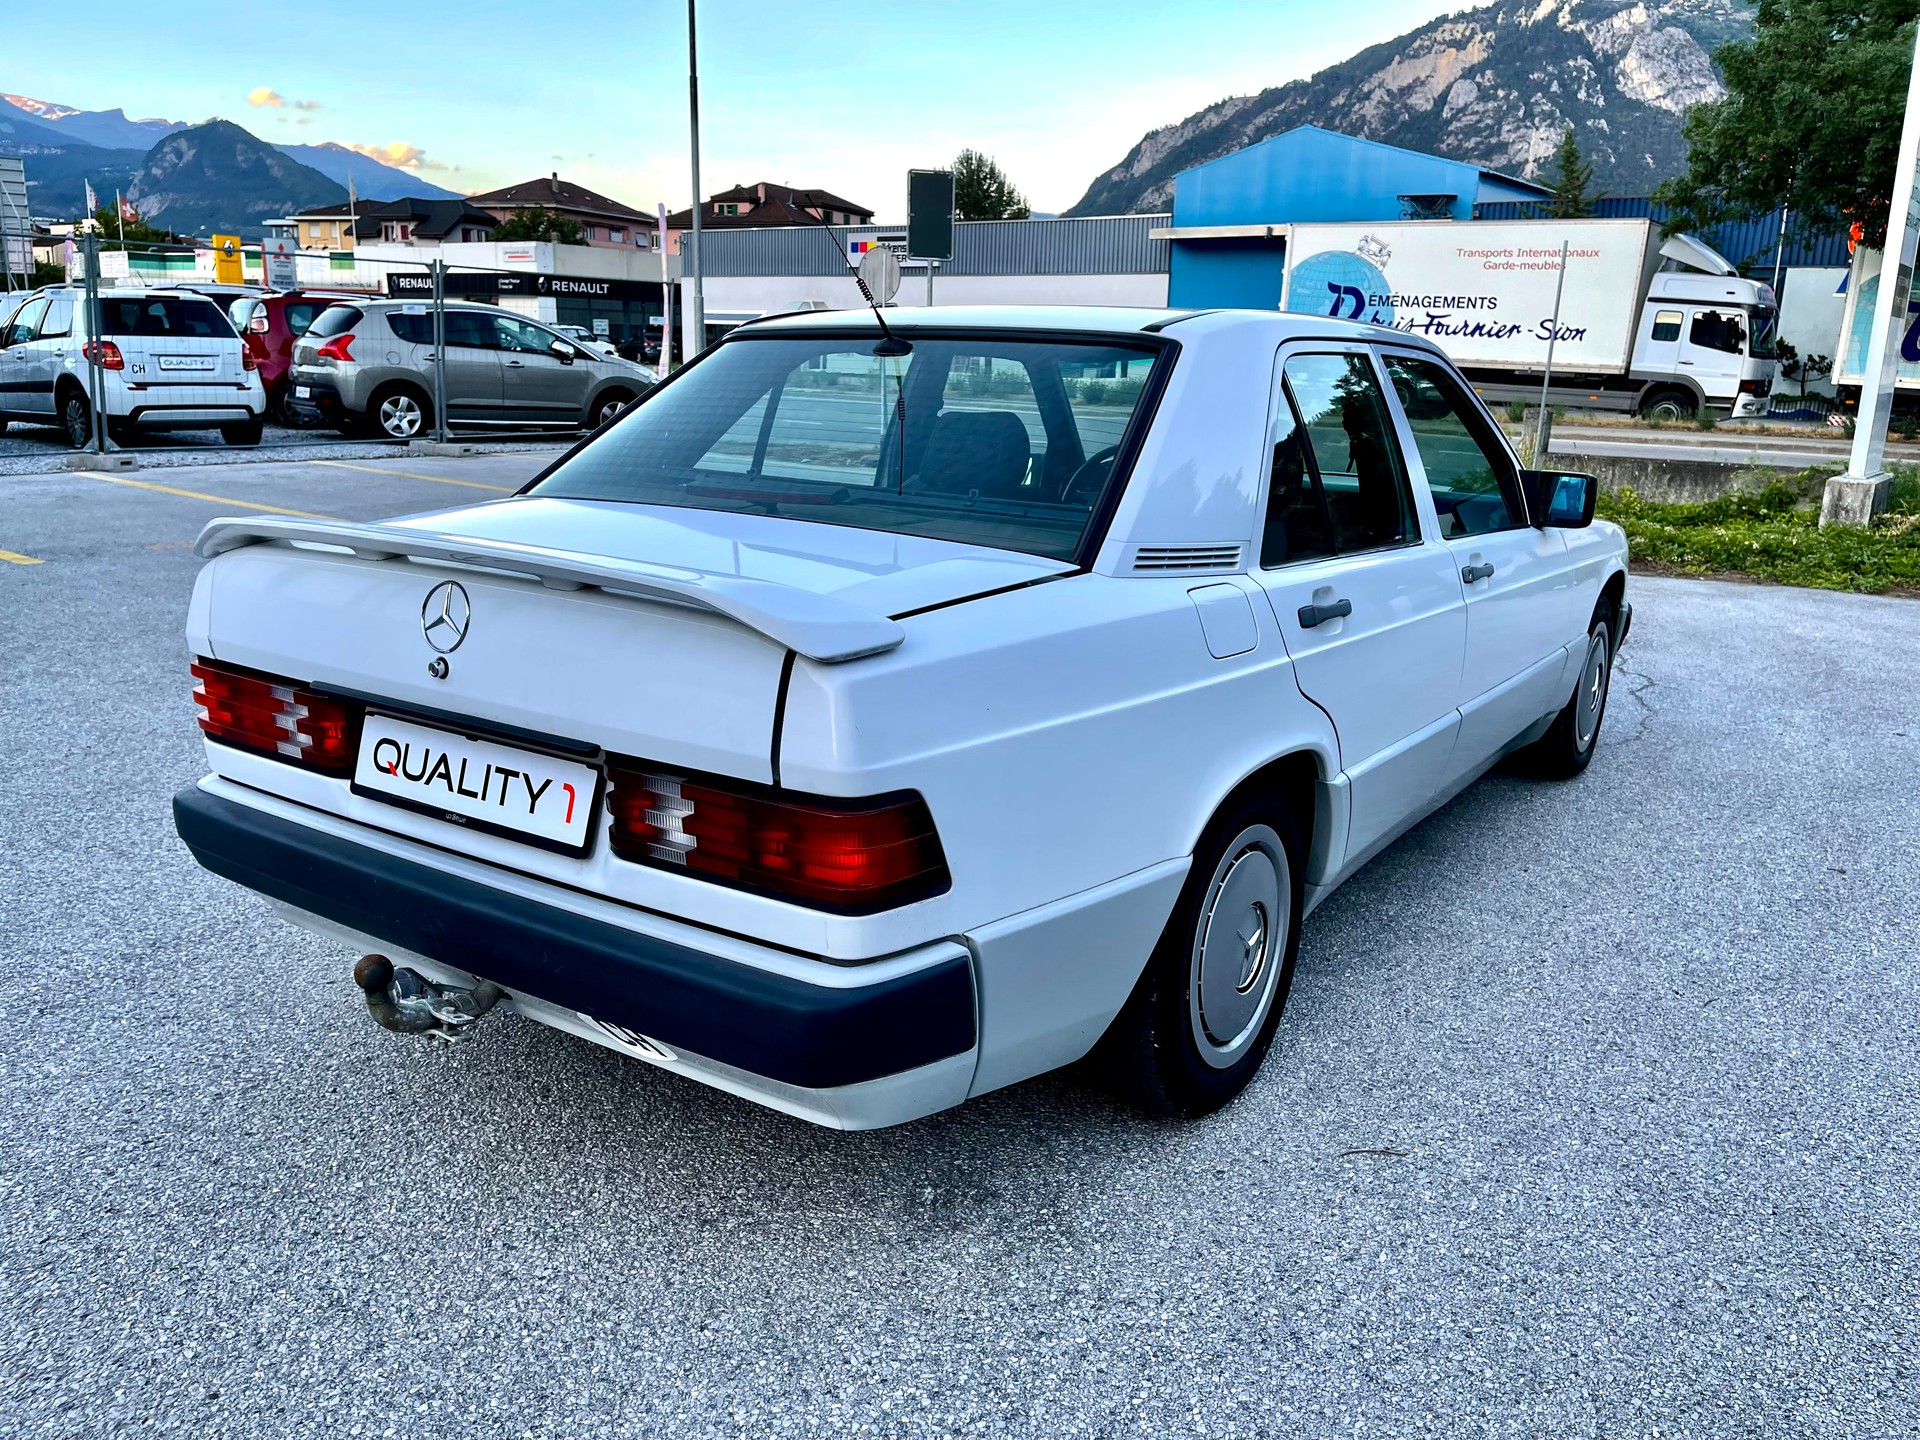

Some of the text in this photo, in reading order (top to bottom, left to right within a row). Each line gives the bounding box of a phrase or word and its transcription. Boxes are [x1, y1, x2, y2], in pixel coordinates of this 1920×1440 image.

[1456, 248, 1600, 259] Transports Internatonaux
[1483, 260, 1566, 271] Garde-meuble
[399, 278, 434, 289] RENAUL
[551, 281, 610, 294] RENAULT
[1424, 311, 1522, 339] Fournier
[1535, 319, 1588, 342] Sion
[163, 359, 205, 367] QUALITY
[131, 364, 146, 374] CH
[373, 737, 576, 824] QUALITY 1
